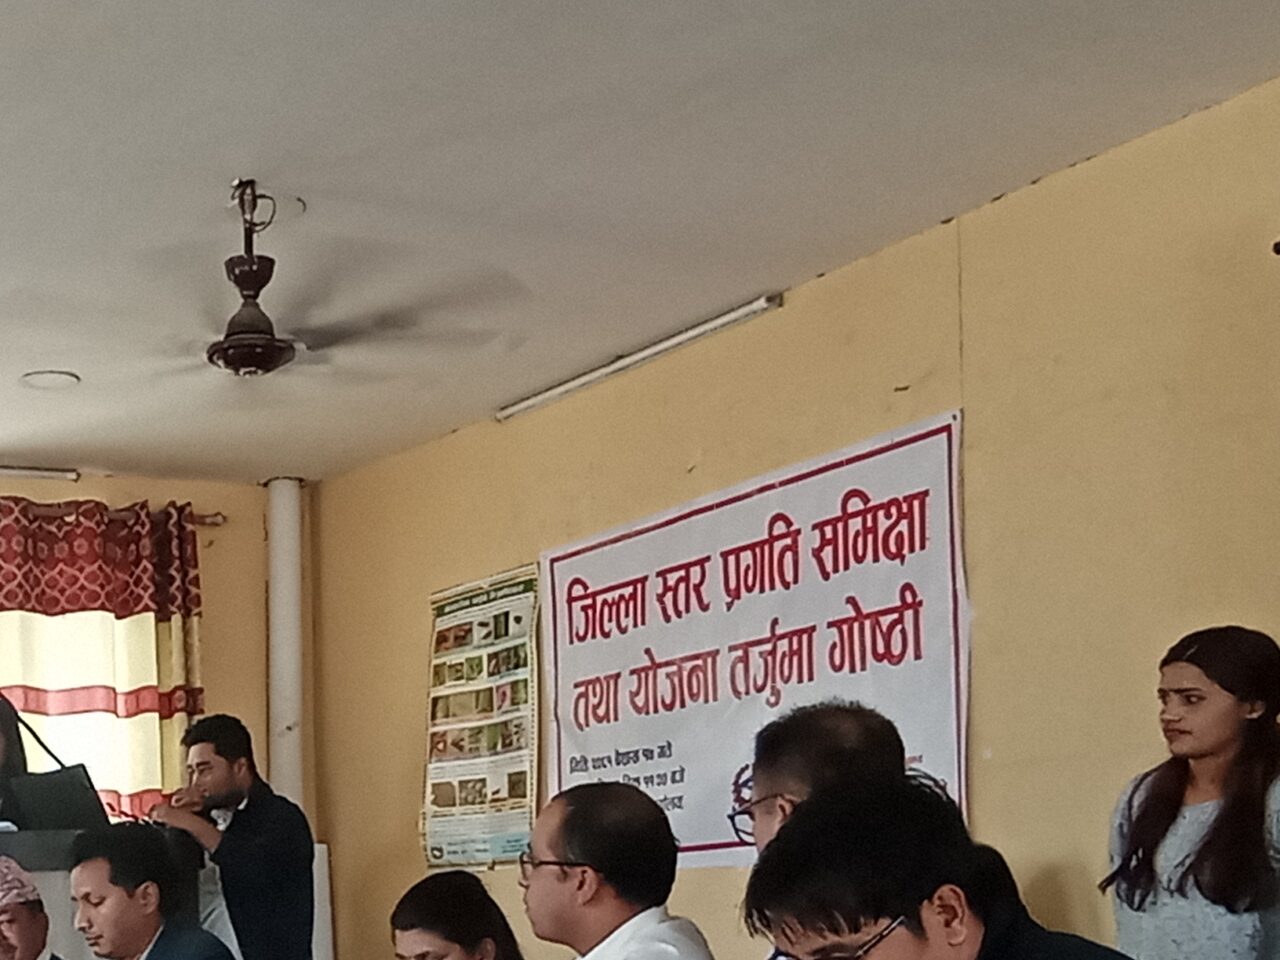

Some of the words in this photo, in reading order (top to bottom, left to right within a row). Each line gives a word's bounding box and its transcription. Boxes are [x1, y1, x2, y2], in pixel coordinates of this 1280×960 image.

[567, 577, 649, 645] जिल्ला
[655, 555, 712, 624] स्तर
[720, 512, 802, 612] प्रगति
[811, 488, 930, 582] समिक्षा
[573, 671, 622, 732] तथा
[628, 647, 721, 716] योजना
[728, 617, 817, 709] तर्जुमा
[826, 582, 924, 675] गोष्ठी
